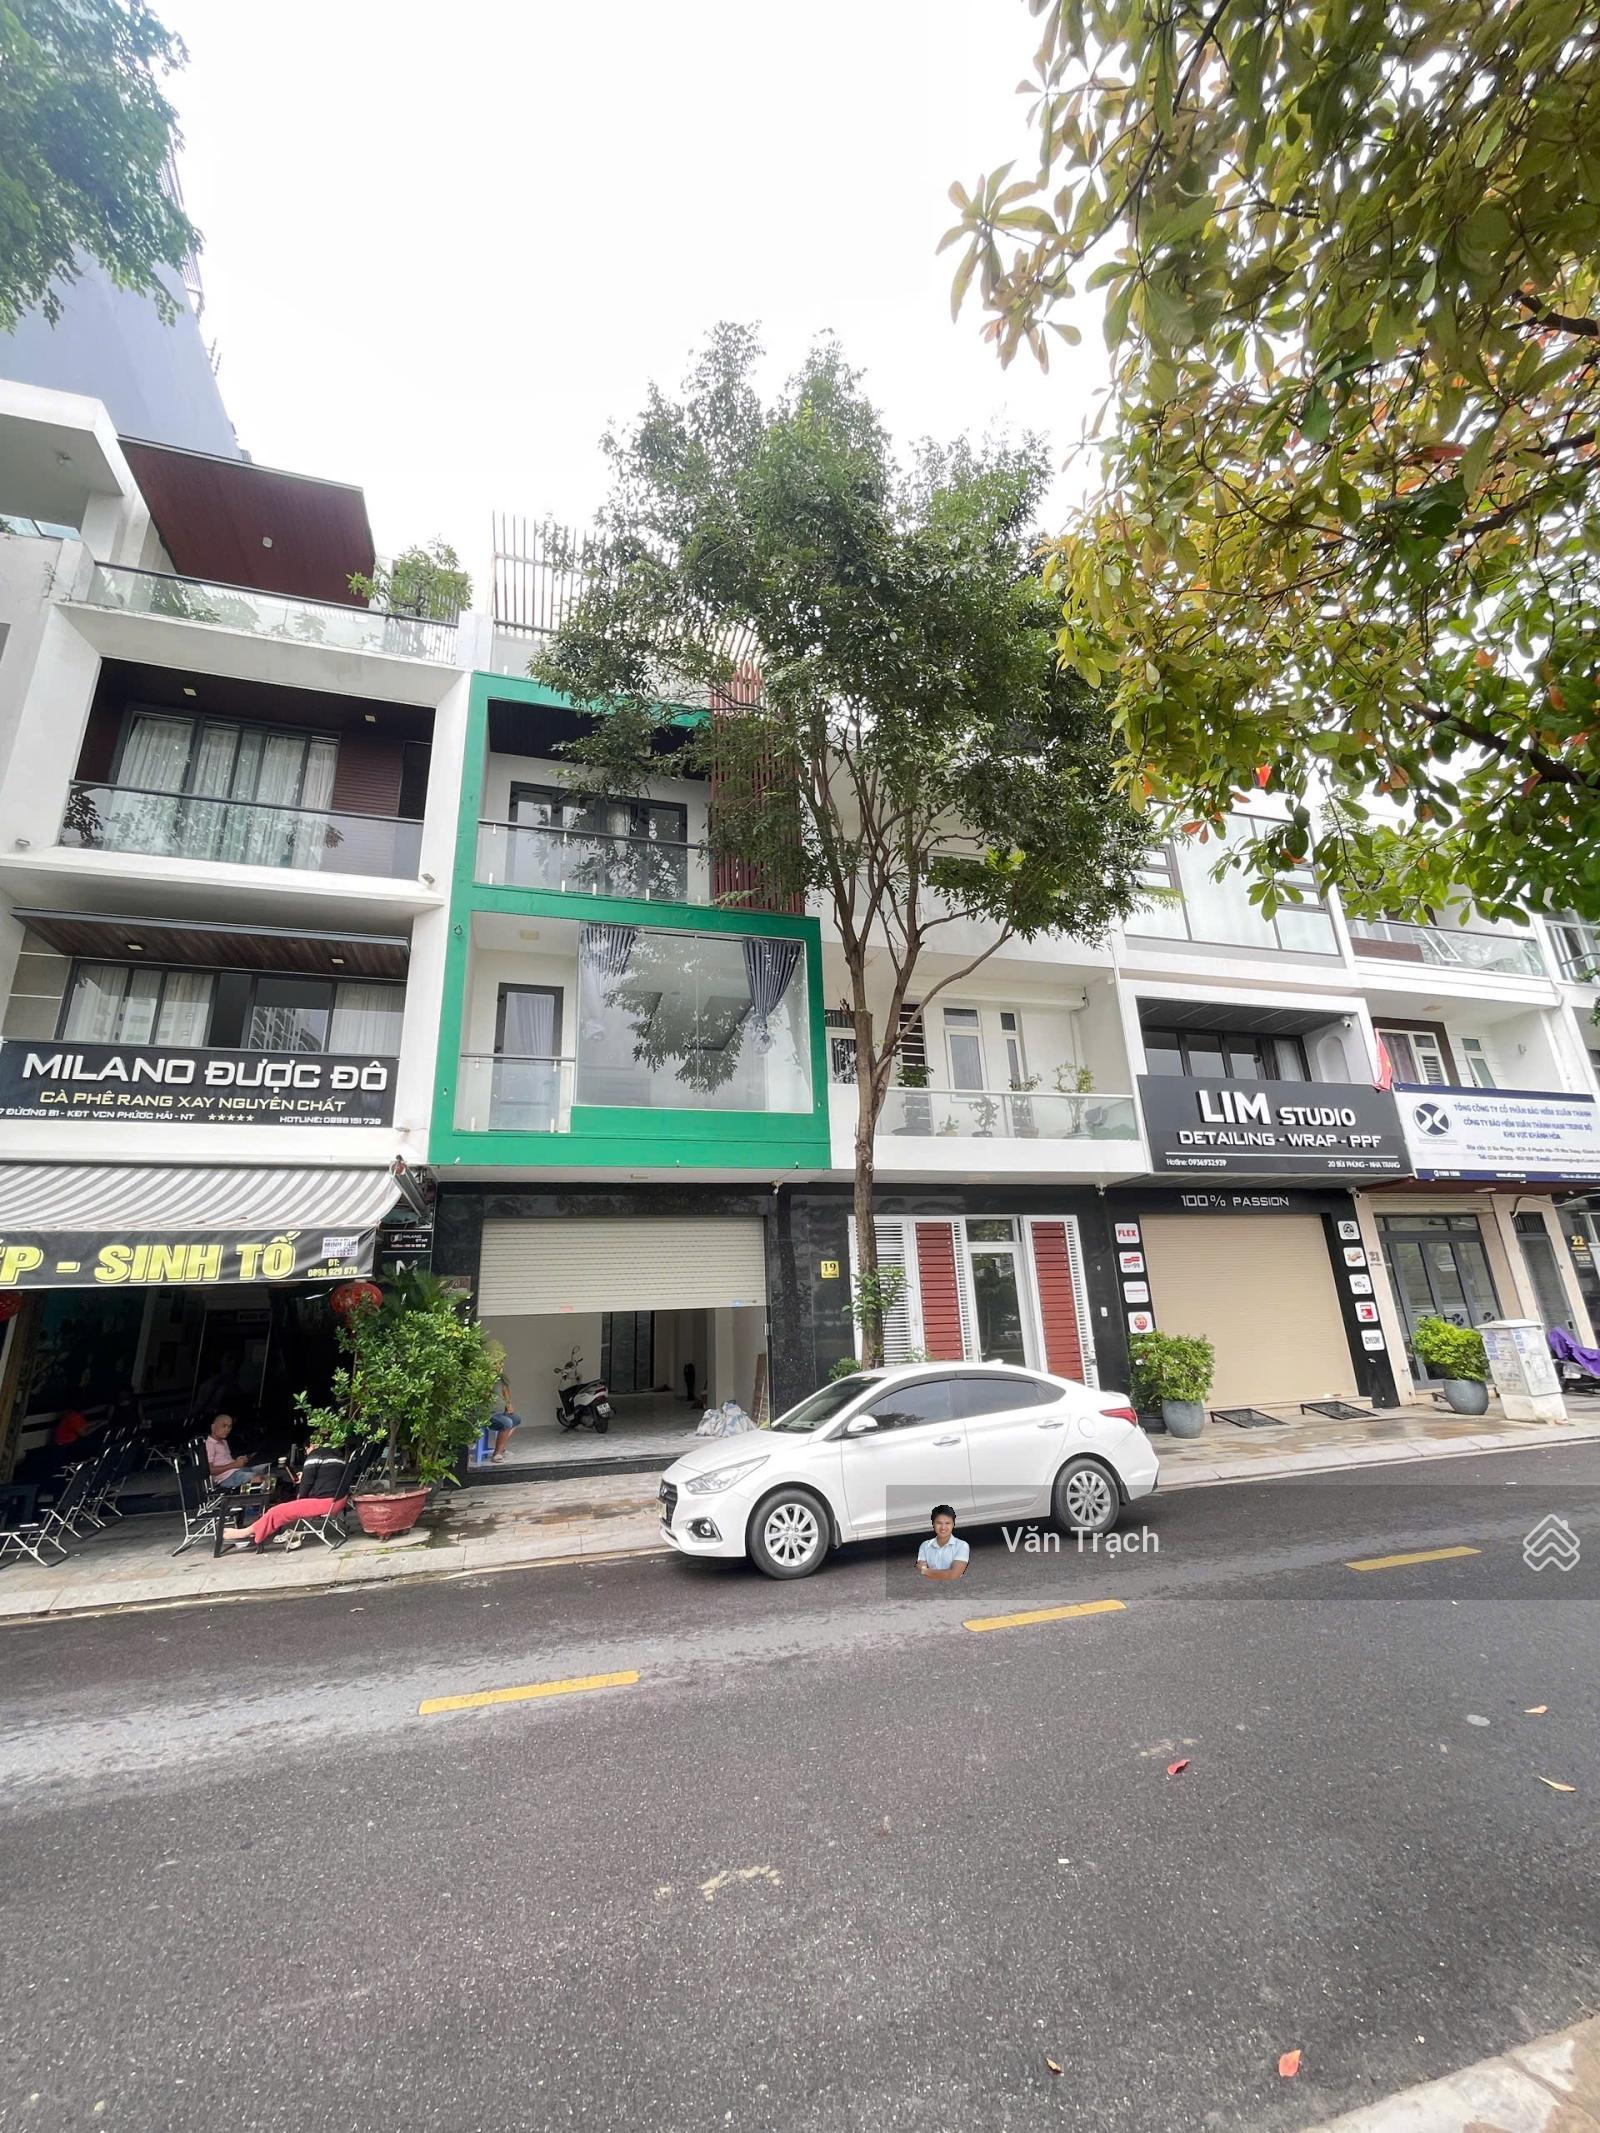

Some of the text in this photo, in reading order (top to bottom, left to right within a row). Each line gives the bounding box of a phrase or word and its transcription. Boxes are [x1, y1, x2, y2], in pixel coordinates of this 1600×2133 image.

[22, 1053, 388, 1094] MILANO ĐƯỢC ĐÔ
[39, 1089, 346, 1112] CÀ PHÊ RANG XAY NGUYÊN CHẤT
[1196, 1089, 1356, 1126] LIM STUDIO
[66, 1110, 90, 1119] KĐT
[92, 1110, 115, 1119] VCN
[180, 1113, 196, 1121] NT
[1178, 1130, 1276, 1146] DETAILING
[1286, 1133, 1337, 1147] WRAP
[1348, 1135, 1382, 1148] PPF
[1166, 1158, 1187, 1166] Hotline:
[1327, 1160, 1335, 1168] 20
[1180, 1194, 1290, 1207] 100% PASSION
[1117, 1229, 1137, 1237] FLEX
[0, 1239, 44, 1286] P
[94, 1243, 224, 1284] SINH
[235, 1230, 302, 1281] TỐ
[823, 1262, 836, 1272] 19
